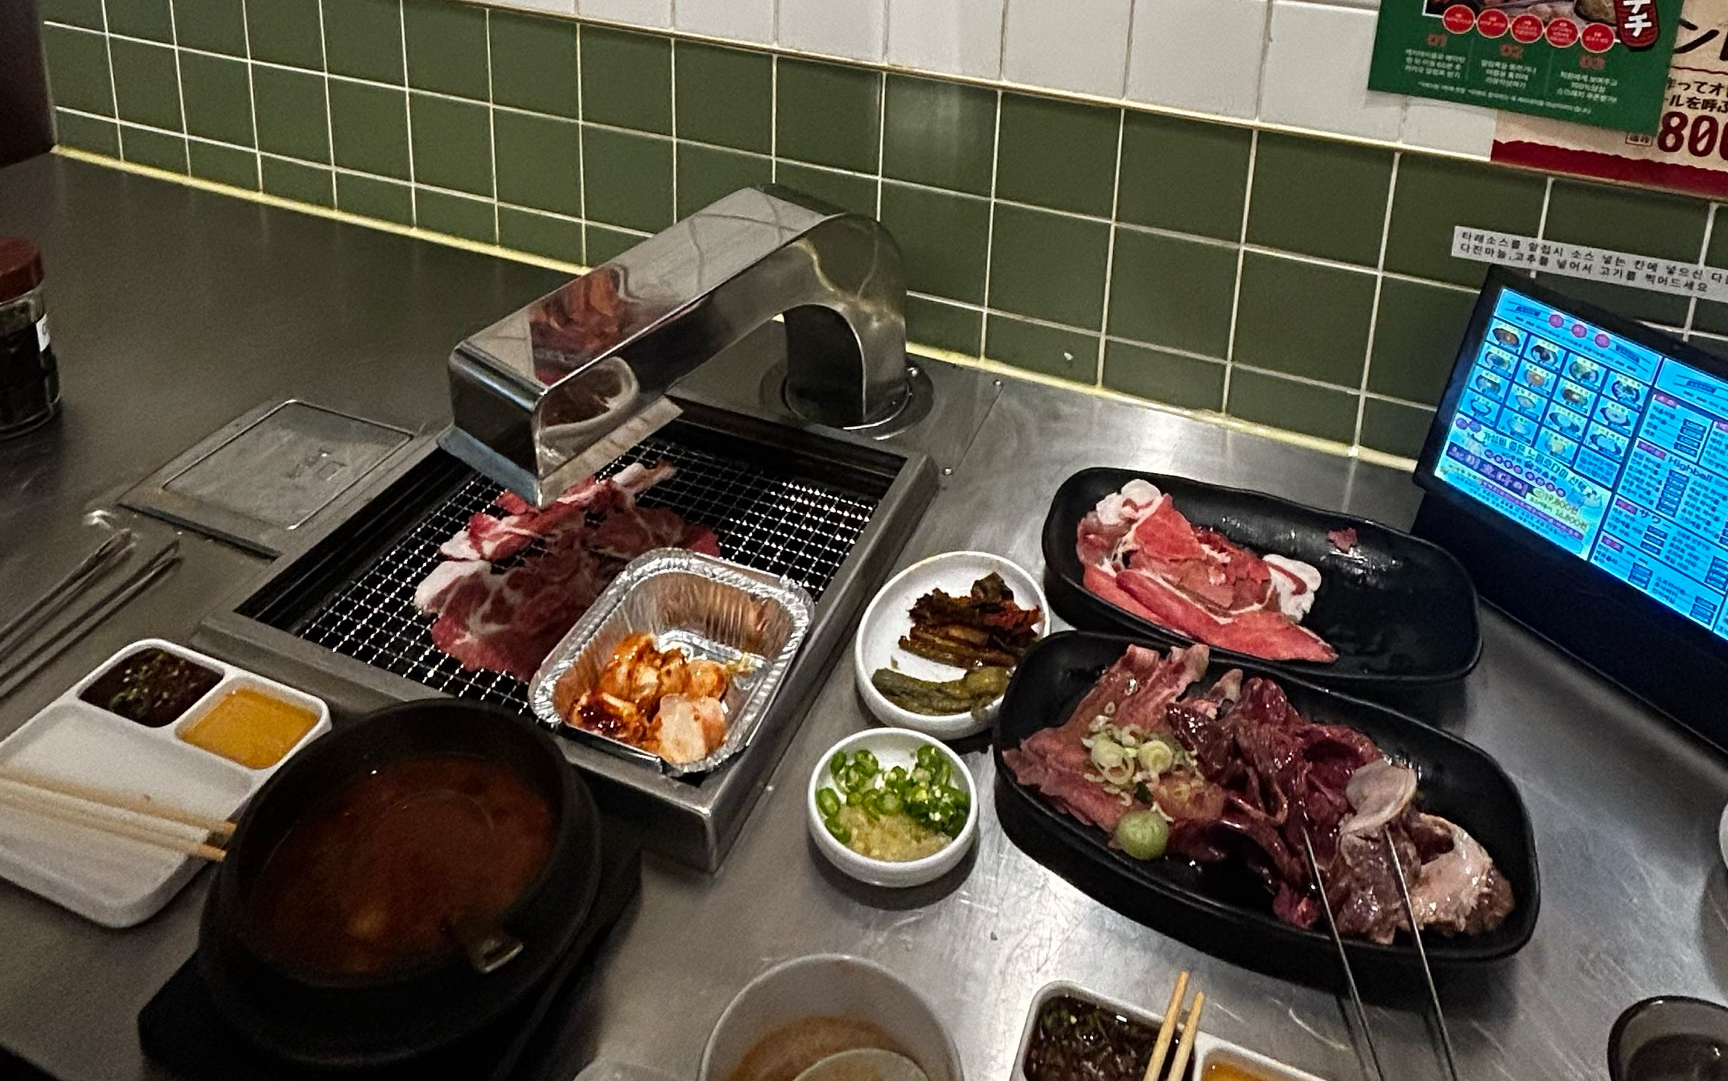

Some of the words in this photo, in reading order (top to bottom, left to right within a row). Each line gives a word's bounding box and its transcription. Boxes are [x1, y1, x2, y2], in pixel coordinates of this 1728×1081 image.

[1673, 19, 1728, 61] ン
[1667, 77, 1728, 96] ってオ
[1657, 111, 1728, 161] 80
[1571, 250, 1594, 262] 소스
[1600, 266, 1636, 281] 고기를
[1668, 456, 1713, 483] Highball
